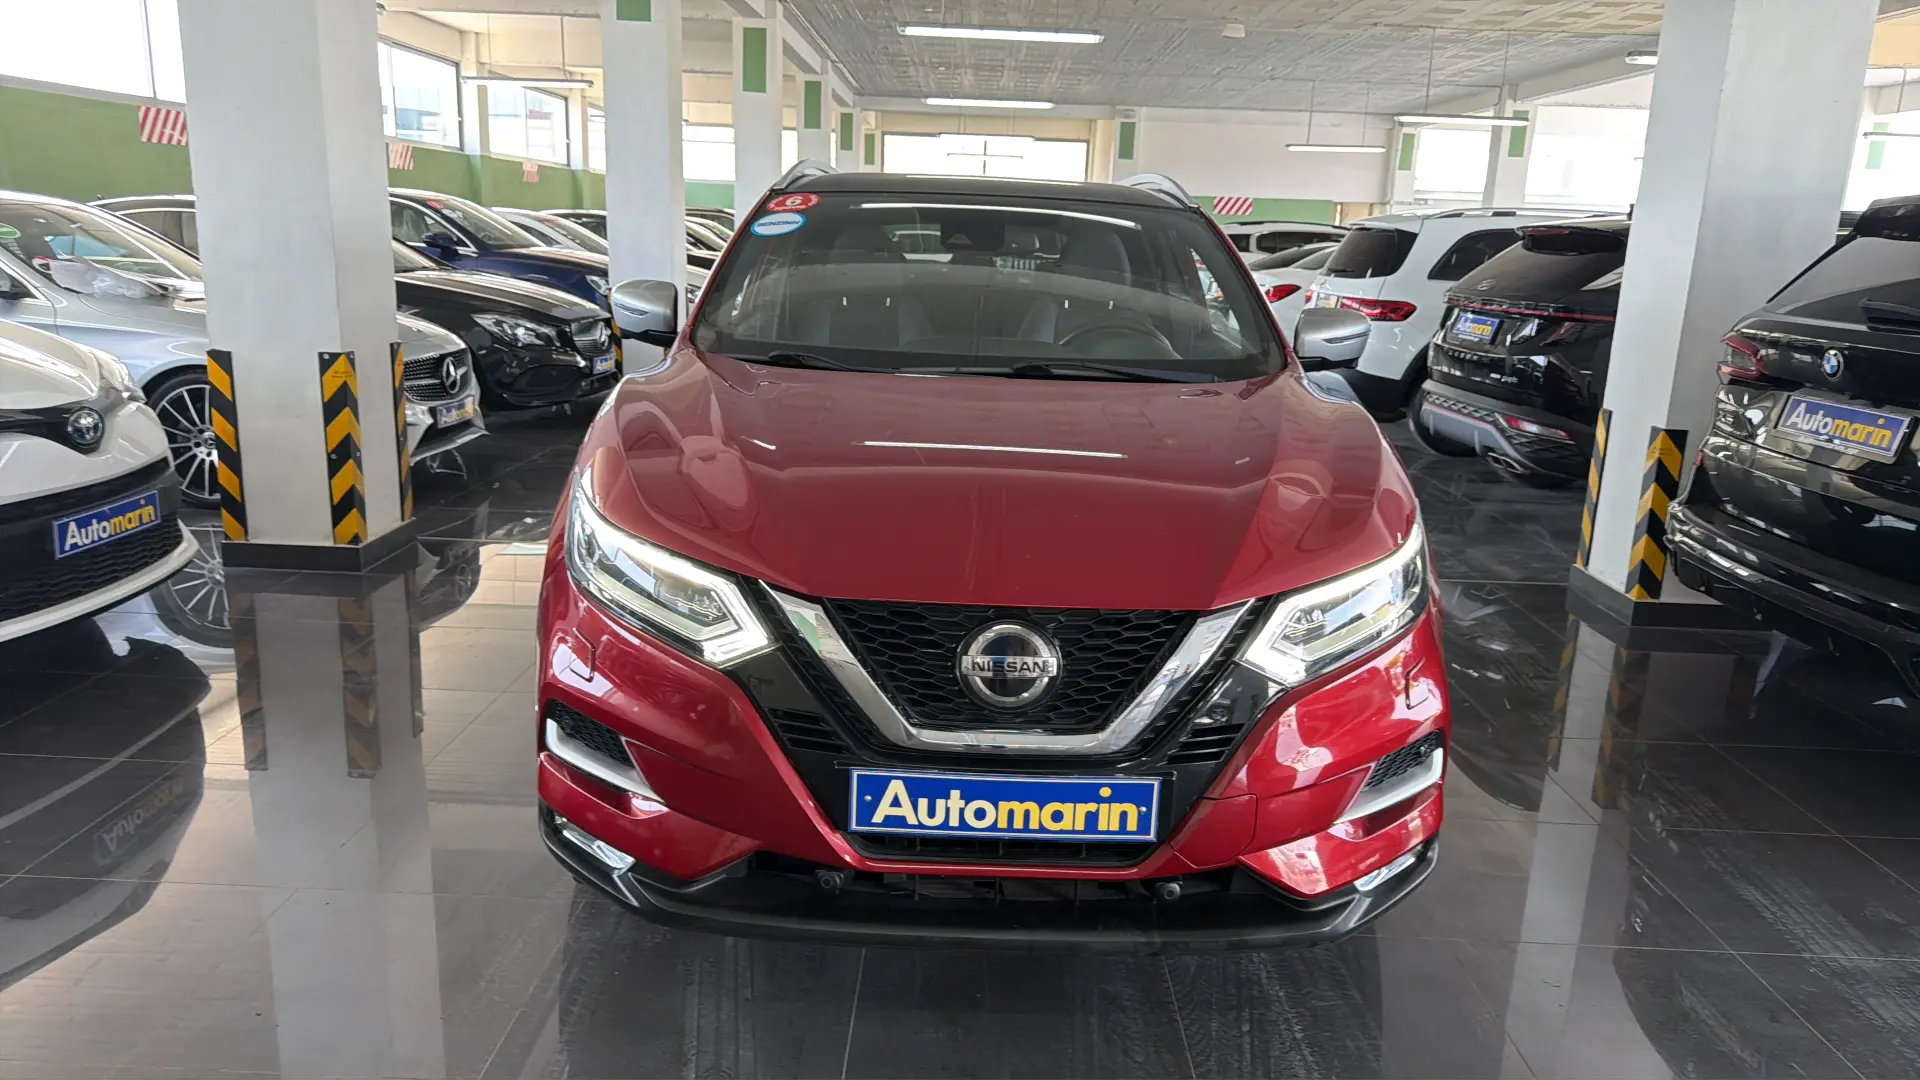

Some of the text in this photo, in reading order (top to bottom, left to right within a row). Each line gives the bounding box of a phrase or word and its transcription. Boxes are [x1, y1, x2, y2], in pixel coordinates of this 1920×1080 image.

[785, 196, 804, 206] 6
[1786, 402, 1892, 448] Automarin
[64, 499, 155, 551] Automarin
[972, 660, 1045, 673] NISSAN
[871, 779, 1138, 832] Automarin
